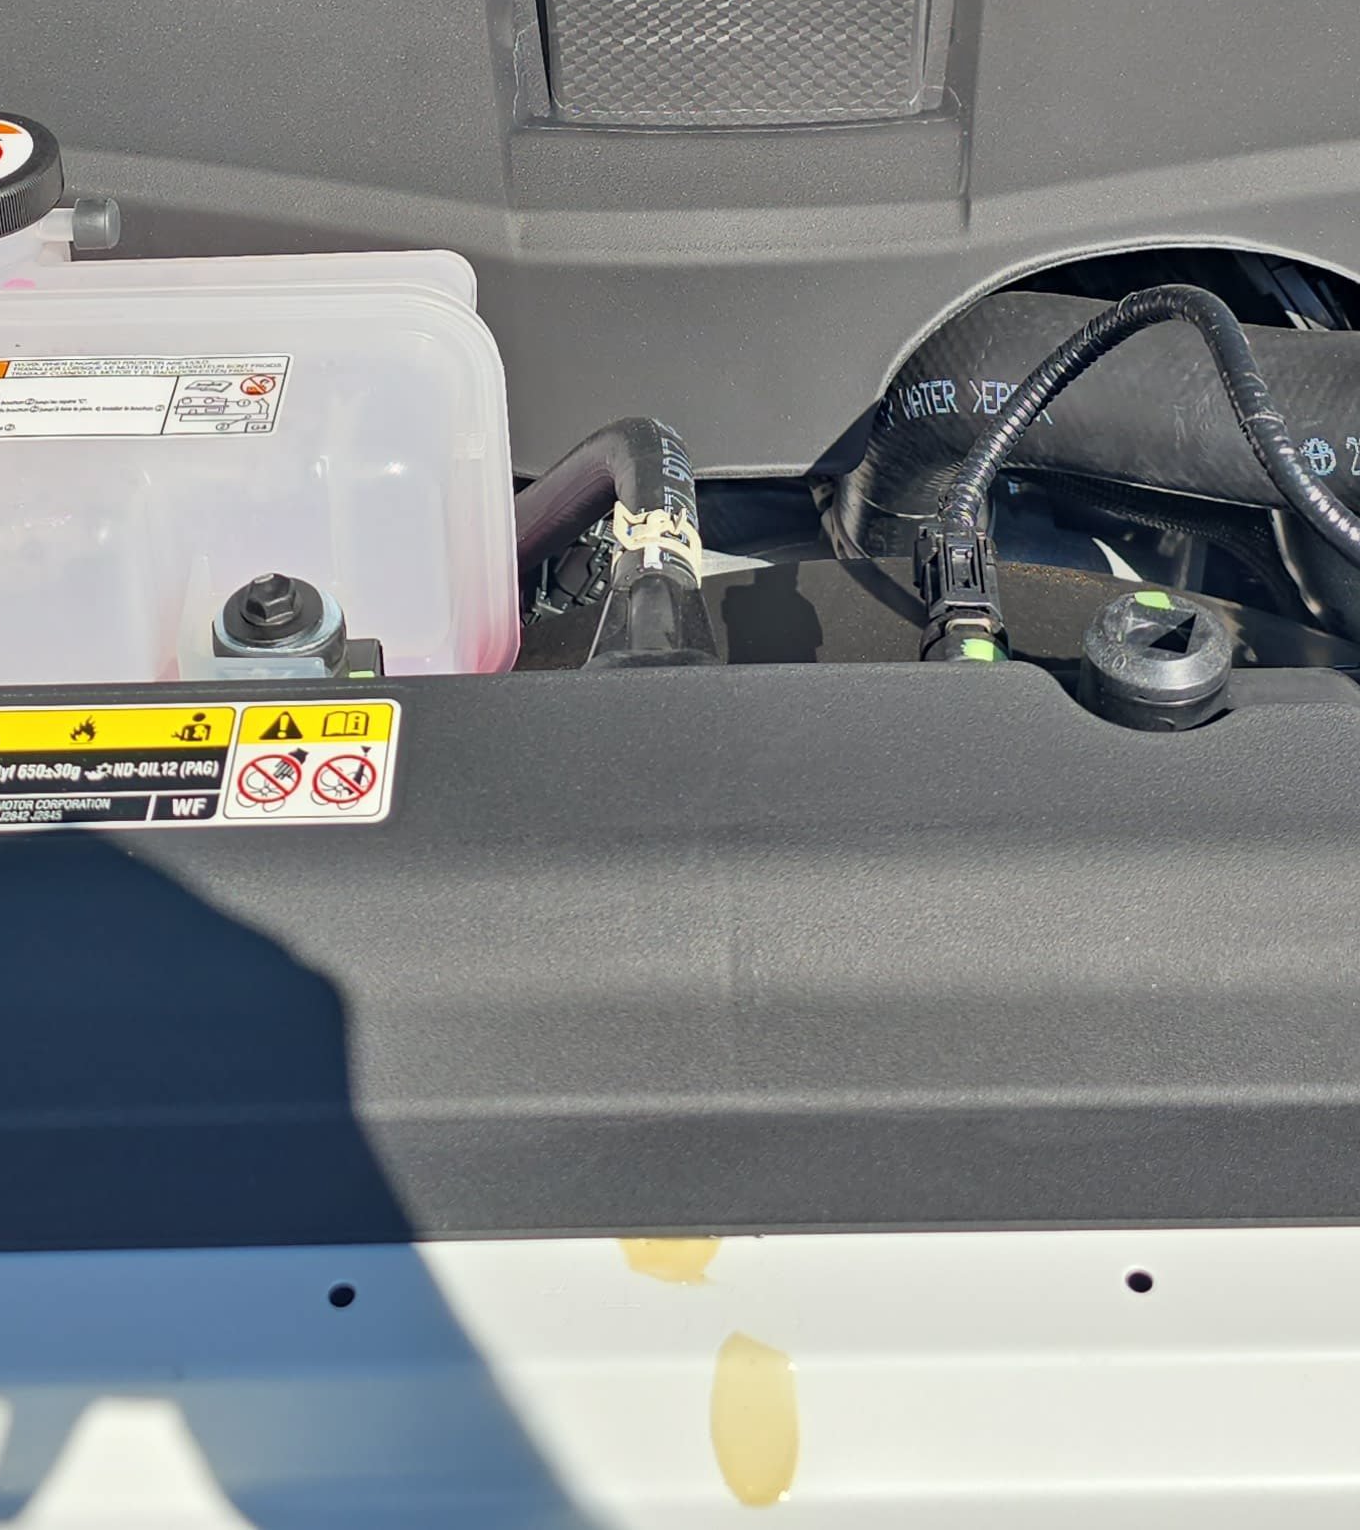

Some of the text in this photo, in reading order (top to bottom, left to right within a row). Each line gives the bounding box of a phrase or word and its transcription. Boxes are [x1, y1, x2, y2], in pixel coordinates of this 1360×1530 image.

[898, 378, 960, 421] WATER
[179, 759, 220, 779] (PAG)
[34, 798, 112, 811] CORPORATION
[171, 797, 208, 816] WF
